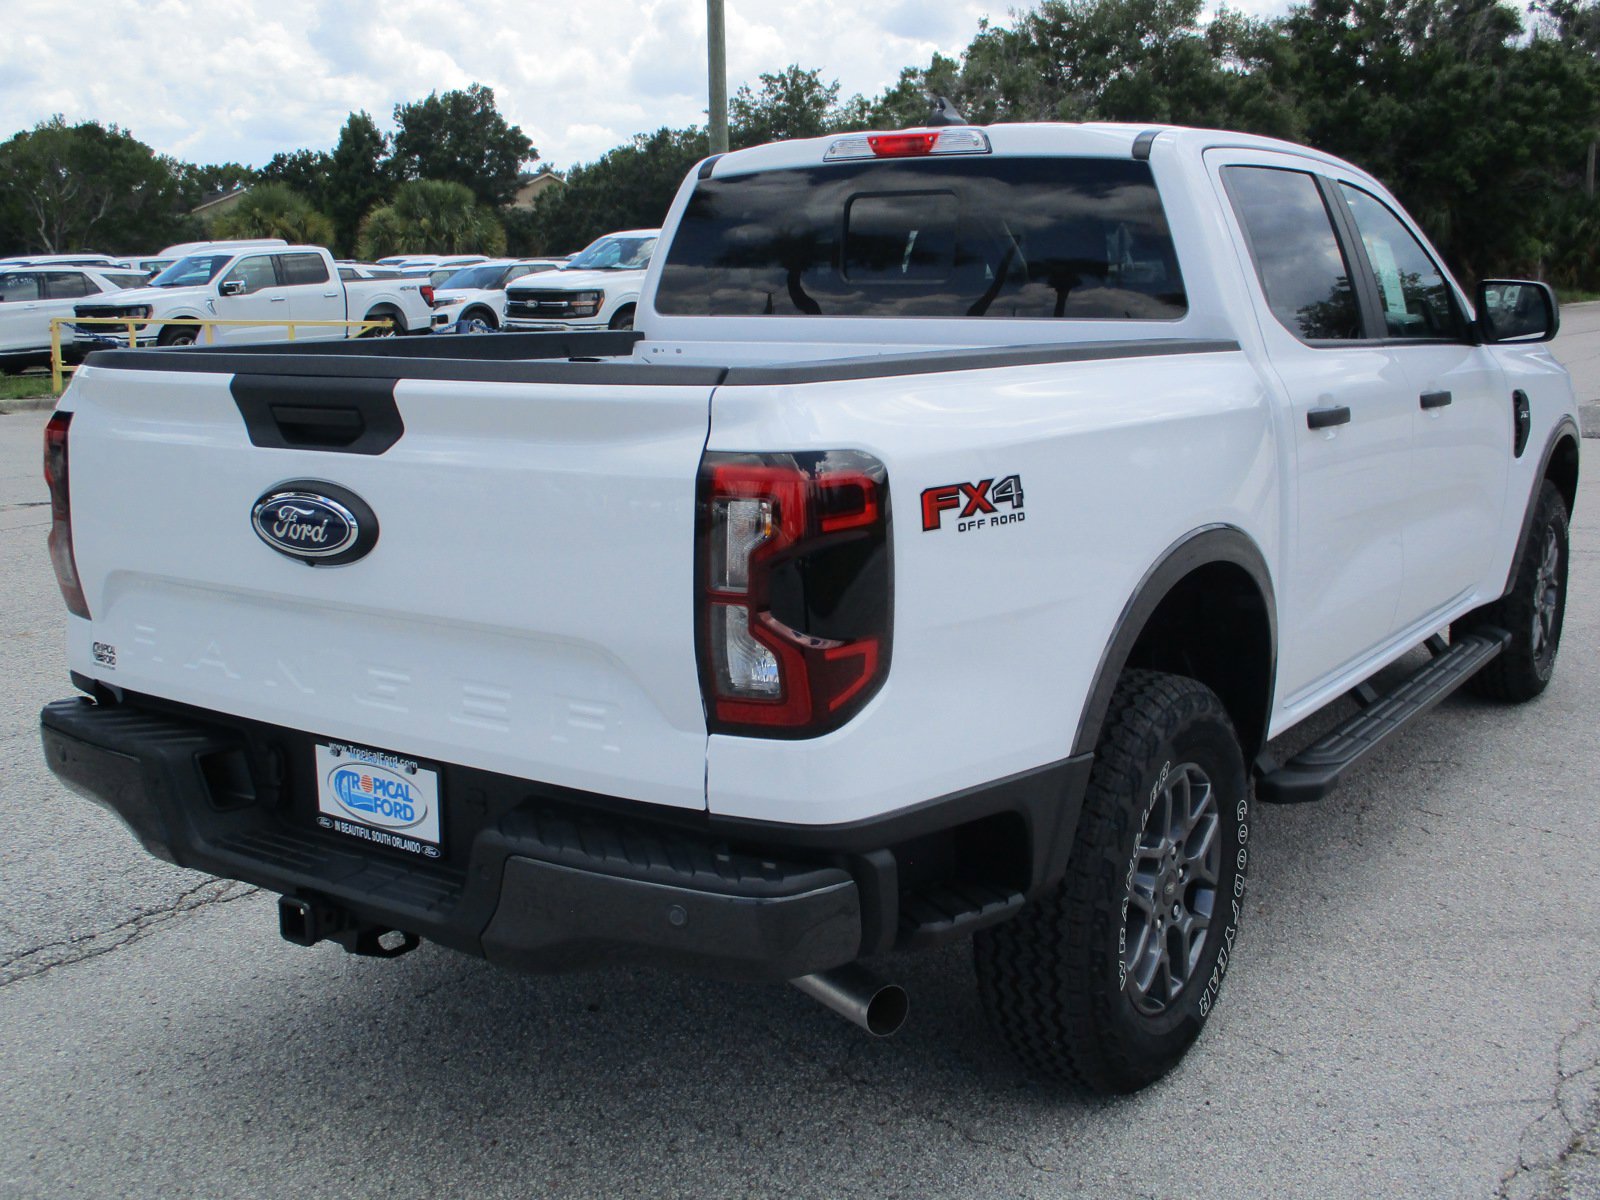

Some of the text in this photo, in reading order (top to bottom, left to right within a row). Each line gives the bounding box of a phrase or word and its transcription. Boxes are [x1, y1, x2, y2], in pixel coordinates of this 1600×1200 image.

[920, 474, 1024, 532] FX4
[273, 505, 328, 542] Ford
[958, 512, 1025, 532] OFF ROAD
[328, 742, 418, 768] www.TropicalFord.com
[334, 770, 413, 803] TROPICAL
[374, 797, 415, 822] FORD
[334, 820, 421, 854] IN BEAUTIFUL SOUTH ORLANDO
[1199, 799, 1248, 1017] GOODYEAR
